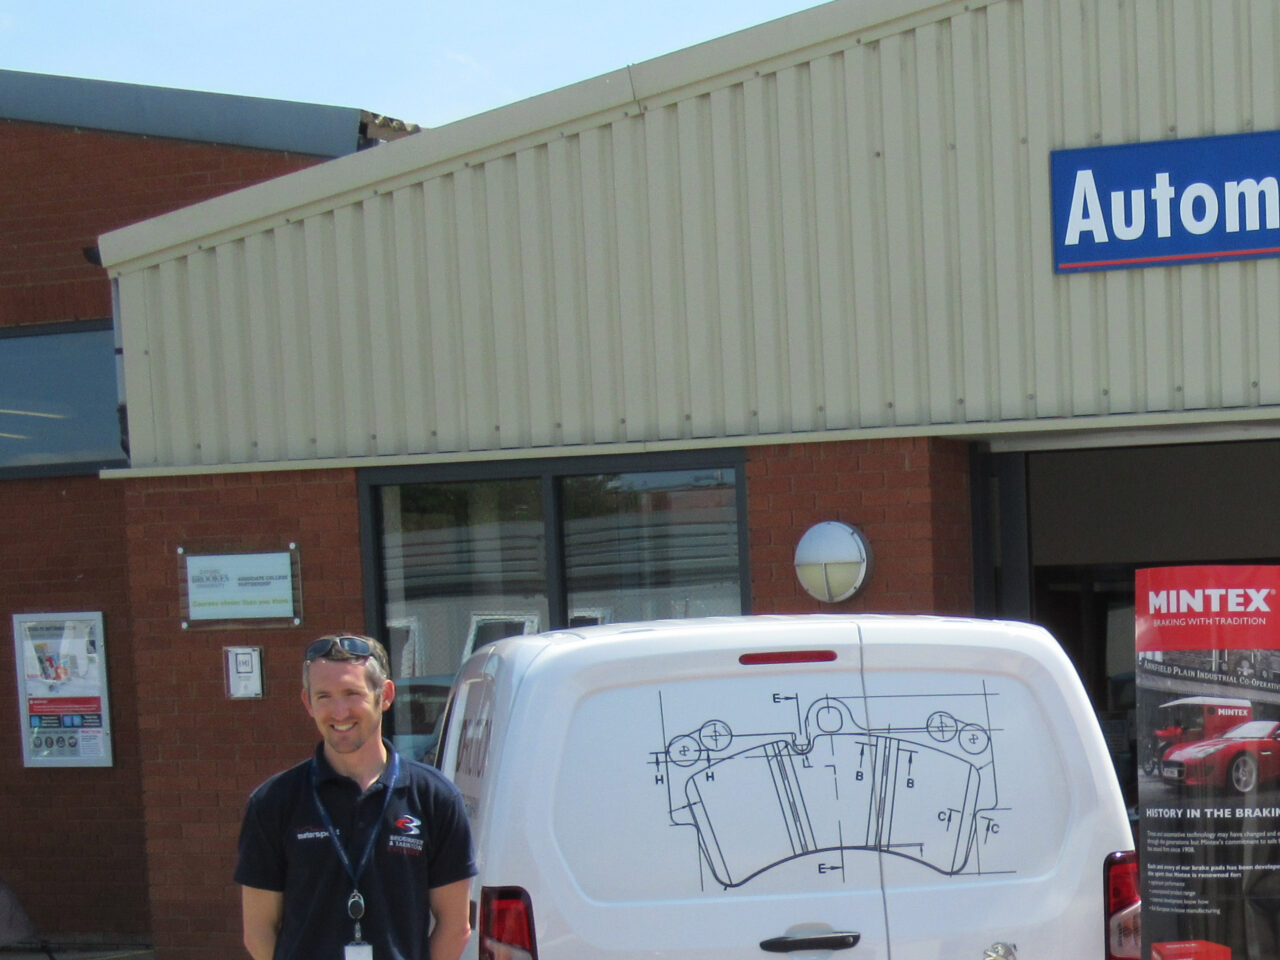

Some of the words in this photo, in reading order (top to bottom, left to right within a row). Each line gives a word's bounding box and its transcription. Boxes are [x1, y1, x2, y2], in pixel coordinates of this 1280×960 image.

[1148, 588, 1271, 614] MINTEX
[1153, 617, 1186, 627] BRAKING
[1187, 617, 1213, 625] WITH
[1215, 616, 1266, 625] TRADITION
[772, 693, 781, 703] E
[1218, 707, 1248, 716] MINTEX
[655, 774, 664, 785] H
[706, 772, 715, 782] H
[856, 770, 864, 782] B
[906, 778, 914, 789] B
[1146, 808, 1183, 818] HISTORY
[1187, 808, 1200, 818] IN
[1204, 808, 1232, 818] THE
[937, 812, 946, 822] C
[990, 823, 1000, 834] C
[818, 864, 827, 874] E
